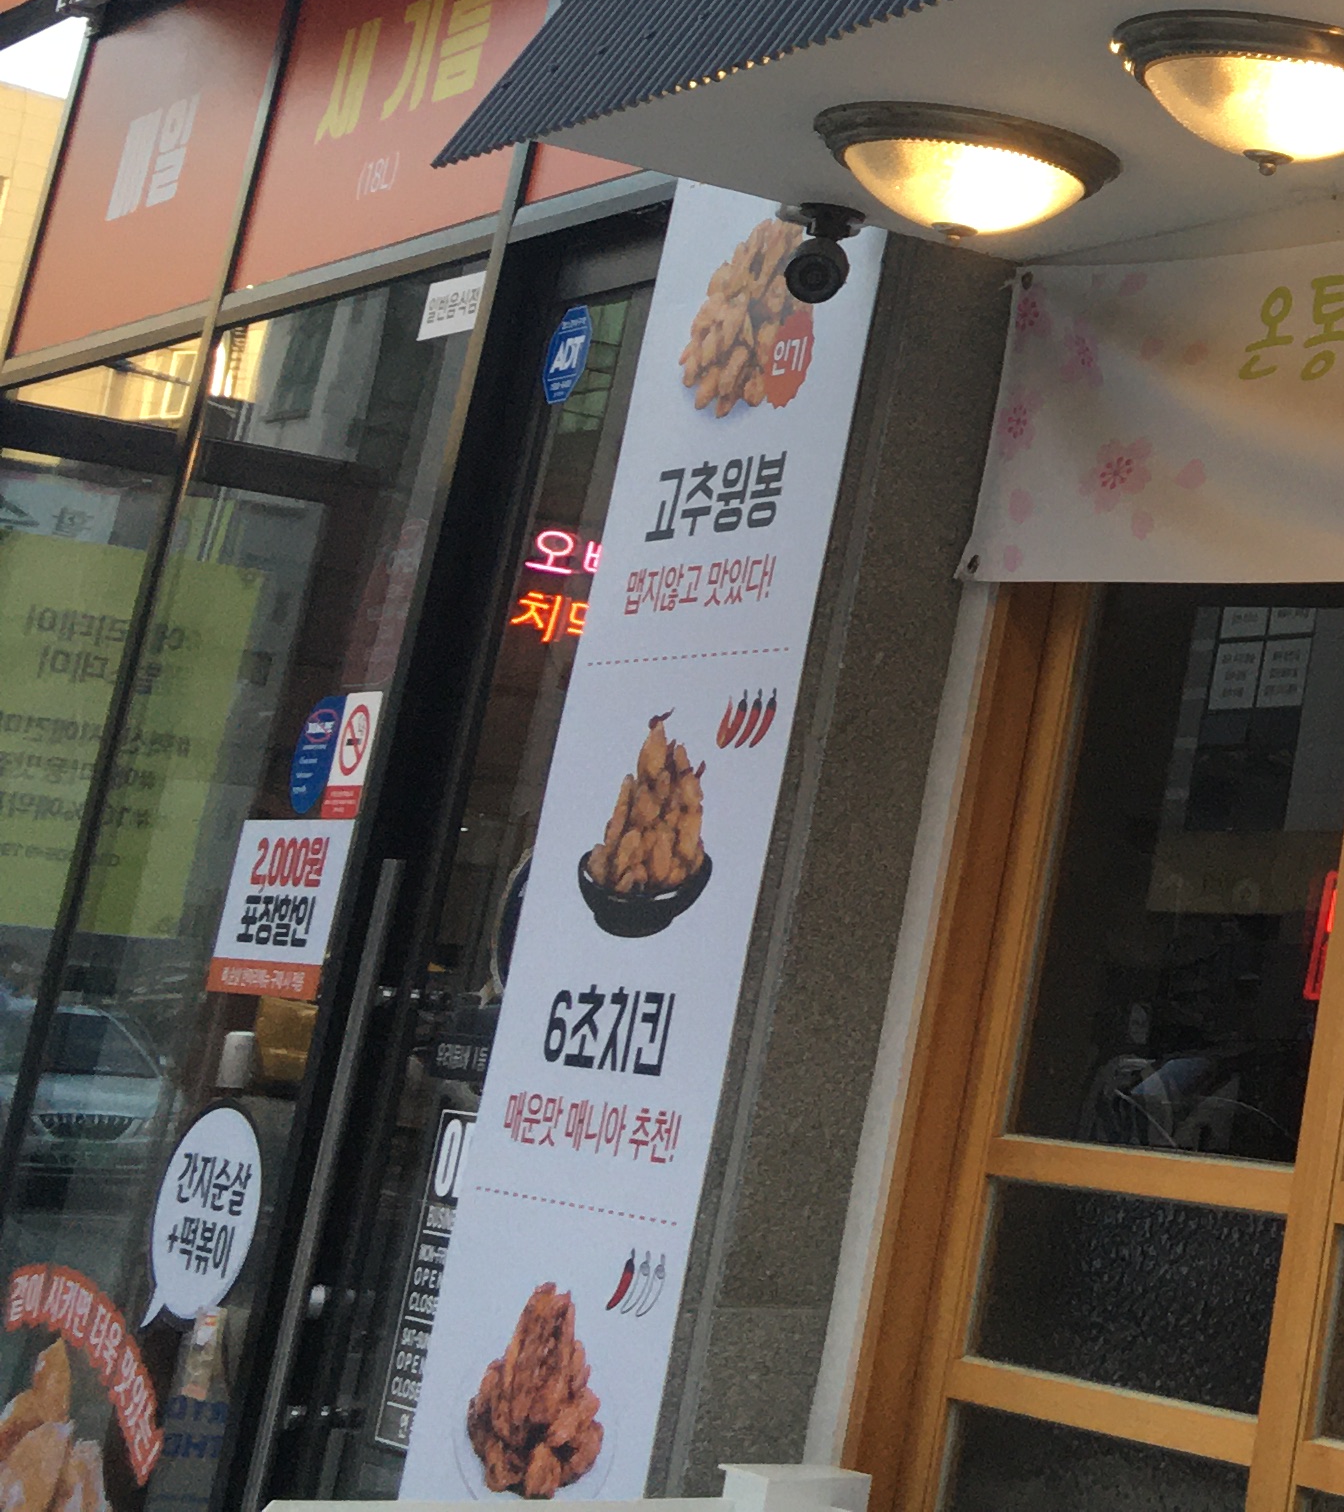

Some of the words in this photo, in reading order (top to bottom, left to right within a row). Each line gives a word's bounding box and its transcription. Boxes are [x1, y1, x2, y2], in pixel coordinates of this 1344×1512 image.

[314, 17, 383, 145] 새
[356, 152, 399, 201] (18L)
[549, 335, 586, 374] ADT
[771, 336, 808, 377] 인기
[644, 450, 788, 543] 고추윙봉
[624, 562, 703, 615] 맵지않고
[703, 553, 777, 608] 맛있다!
[250, 836, 330, 894] 2,000원
[236, 894, 316, 947] 포장할인
[543, 984, 676, 1077] 6초치킨
[503, 1091, 563, 1147] 매운맛
[564, 1099, 627, 1157] 매니아
[628, 1108, 682, 1164] 추천!
[177, 1153, 253, 1216] 간지순살
[167, 1216, 236, 1279] +떡볶이
[9, 1272, 45, 1322] 같이
[43, 1276, 94, 1337] 시키면
